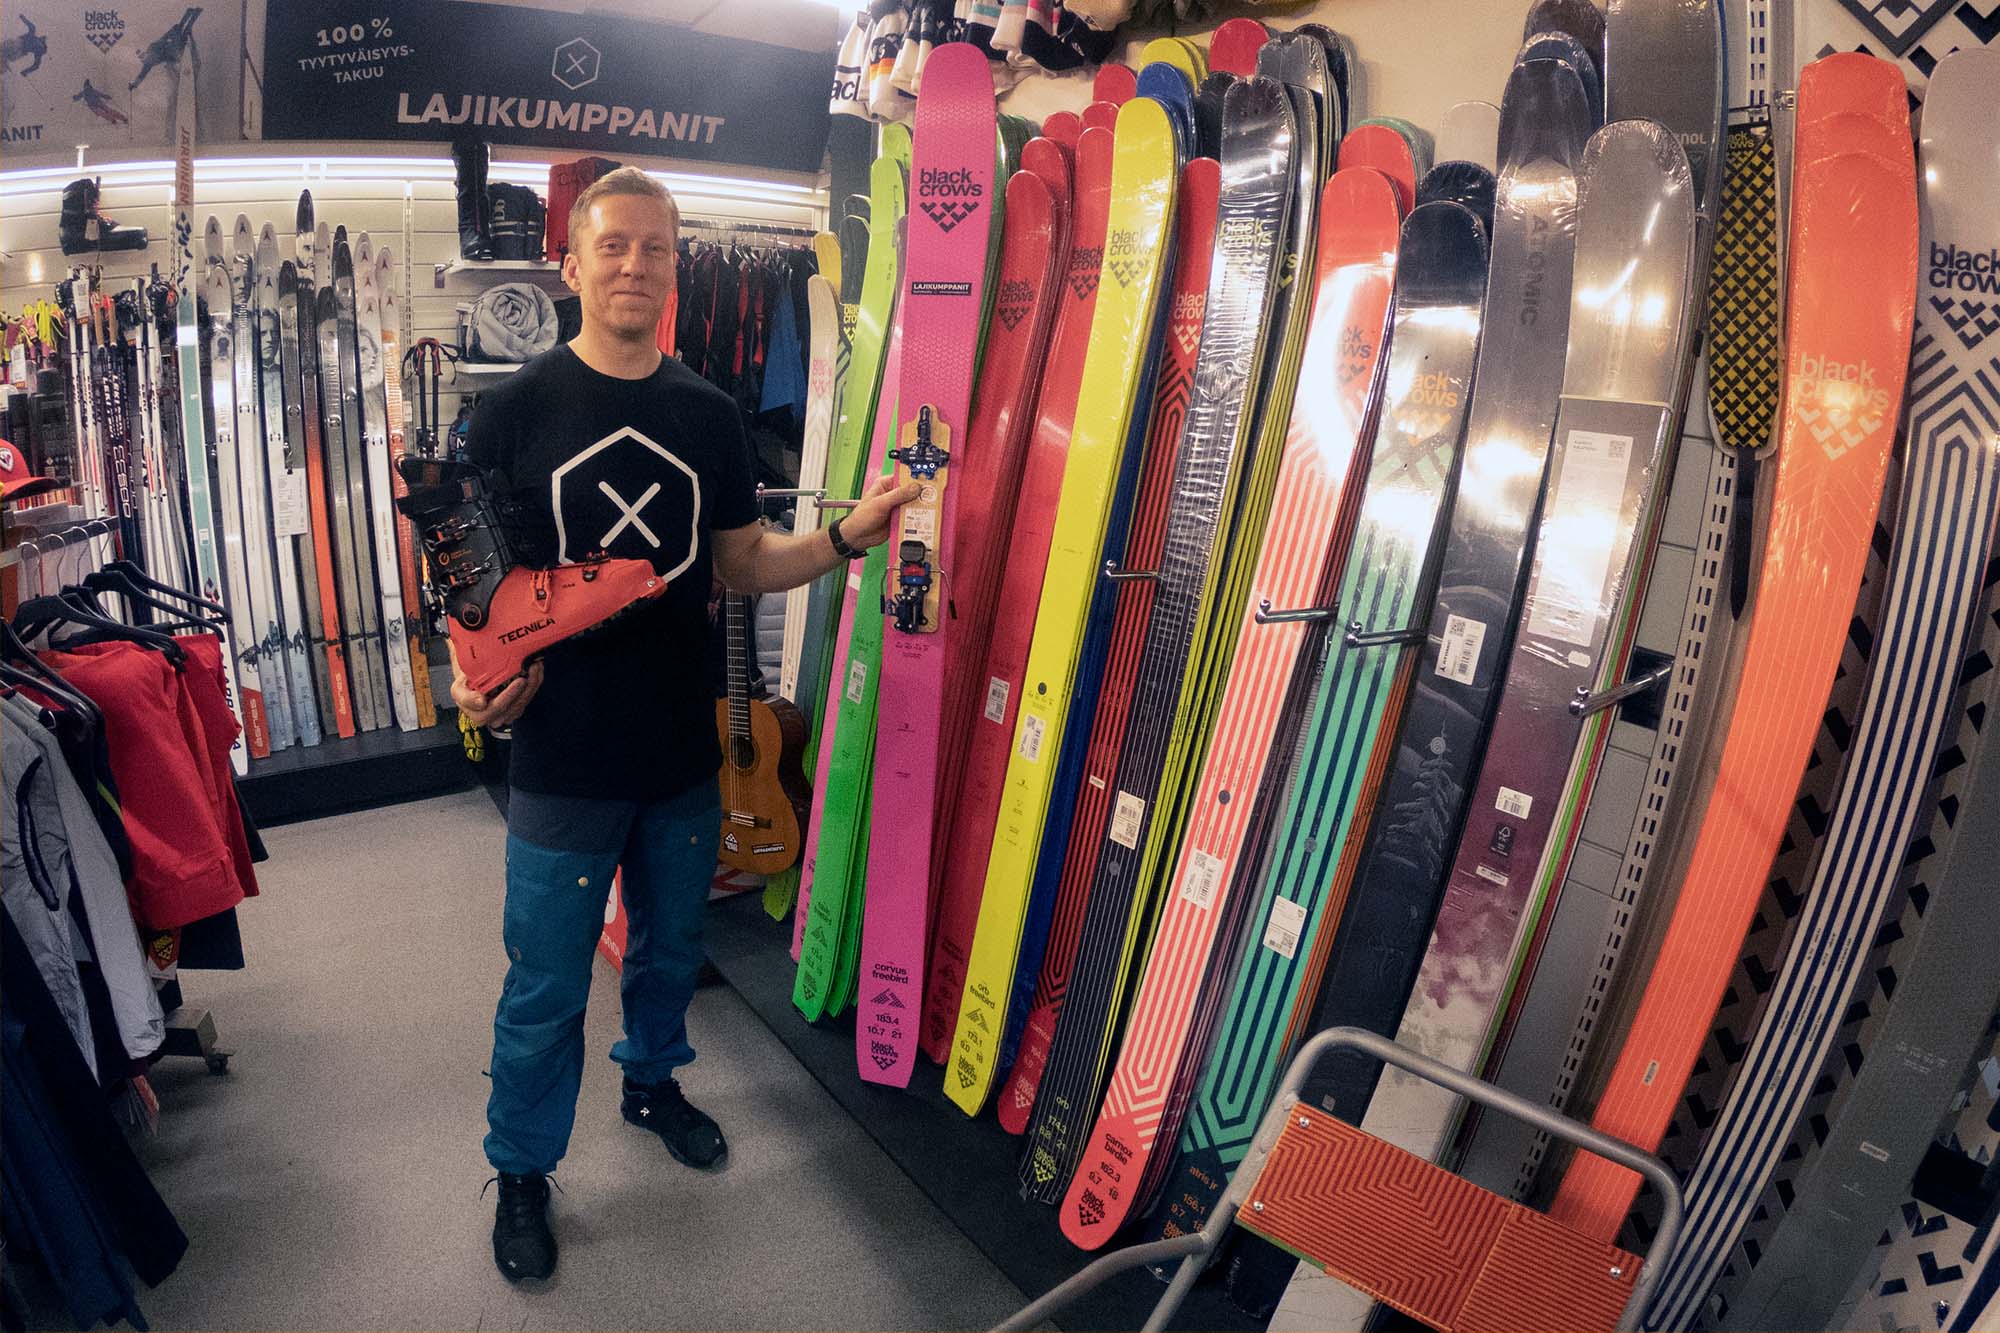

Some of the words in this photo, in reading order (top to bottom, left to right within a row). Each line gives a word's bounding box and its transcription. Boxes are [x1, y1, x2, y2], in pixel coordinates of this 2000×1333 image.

[85, 9, 118, 21] black
[84, 19, 125, 31] crows
[316, 23, 365, 46] 100
[371, 16, 393, 38] %
[298, 45, 415, 71] TYYTYVÄISYYS-
[333, 66, 385, 84] TAKUU
[397, 91, 726, 145] LAJIKUMPPANIT
[919, 168, 973, 184] black
[918, 183, 983, 197] crows
[1800, 351, 1875, 386] black
[497, 618, 556, 645] TECNICA
[872, 970, 909, 984] freebird
[874, 963, 907, 975] corvus
[969, 985, 996, 1010] freebird
[977, 983, 990, 996] orb
[875, 1013, 900, 1026] 183.4
[866, 1025, 886, 1037] 10.7
[891, 1030, 903, 1040] 21
[871, 1040, 895, 1052] black
[1056, 1096, 1070, 1111] orb
[1104, 1142, 1128, 1166] birdie
[1105, 1133, 1134, 1159] camox
[1100, 1161, 1121, 1183] 162.3
